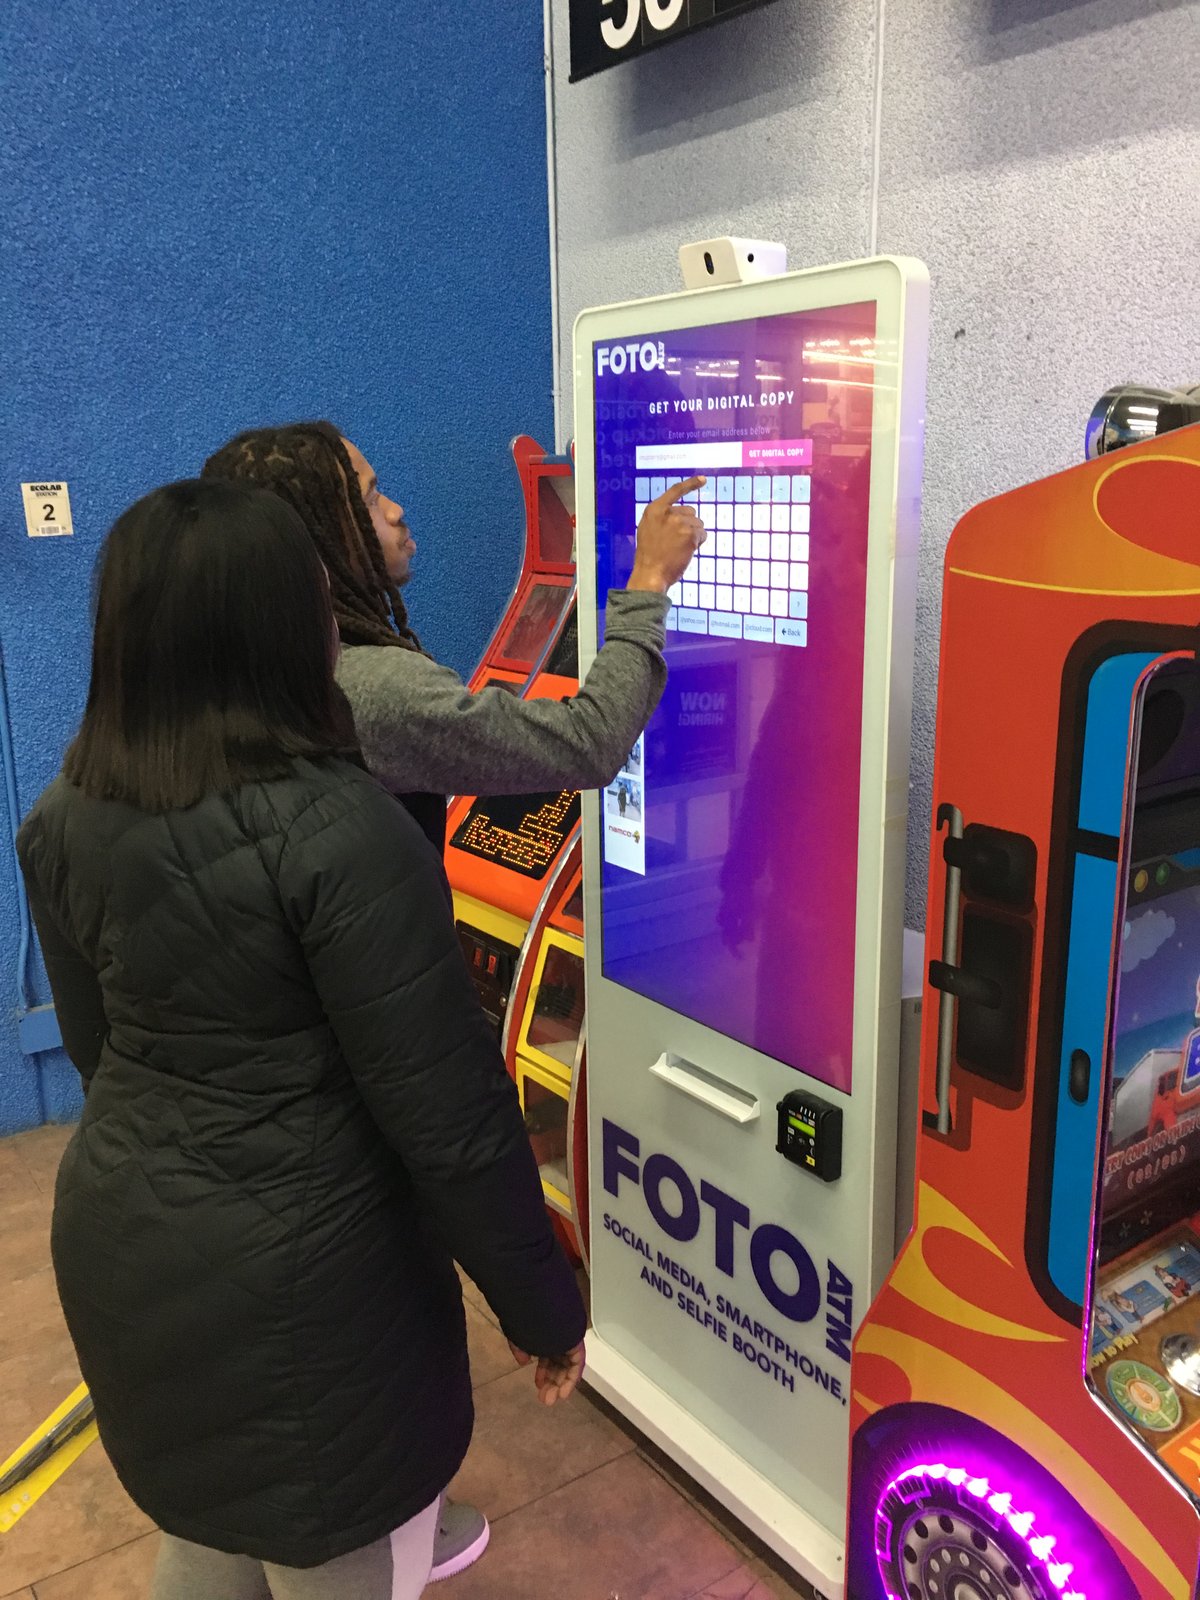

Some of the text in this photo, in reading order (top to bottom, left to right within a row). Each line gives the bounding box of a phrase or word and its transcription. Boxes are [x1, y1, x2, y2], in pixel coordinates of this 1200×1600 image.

[597, 341, 658, 376] FOTO
[649, 391, 794, 414] GET YOUR DIGITAL COPY
[669, 426, 771, 440] Enter your email address below
[749, 448, 804, 458] GET DIGITAL COPY
[42, 503, 56, 521] 2
[787, 628, 801, 637] Back
[608, 824, 633, 838] namco
[602, 1117, 853, 1364] FOTO ATM
[603, 1213, 847, 1406] SOCIAL MEDIA, SMARTPHONE,
[640, 1265, 794, 1393] AND SELFIE BOOTH
